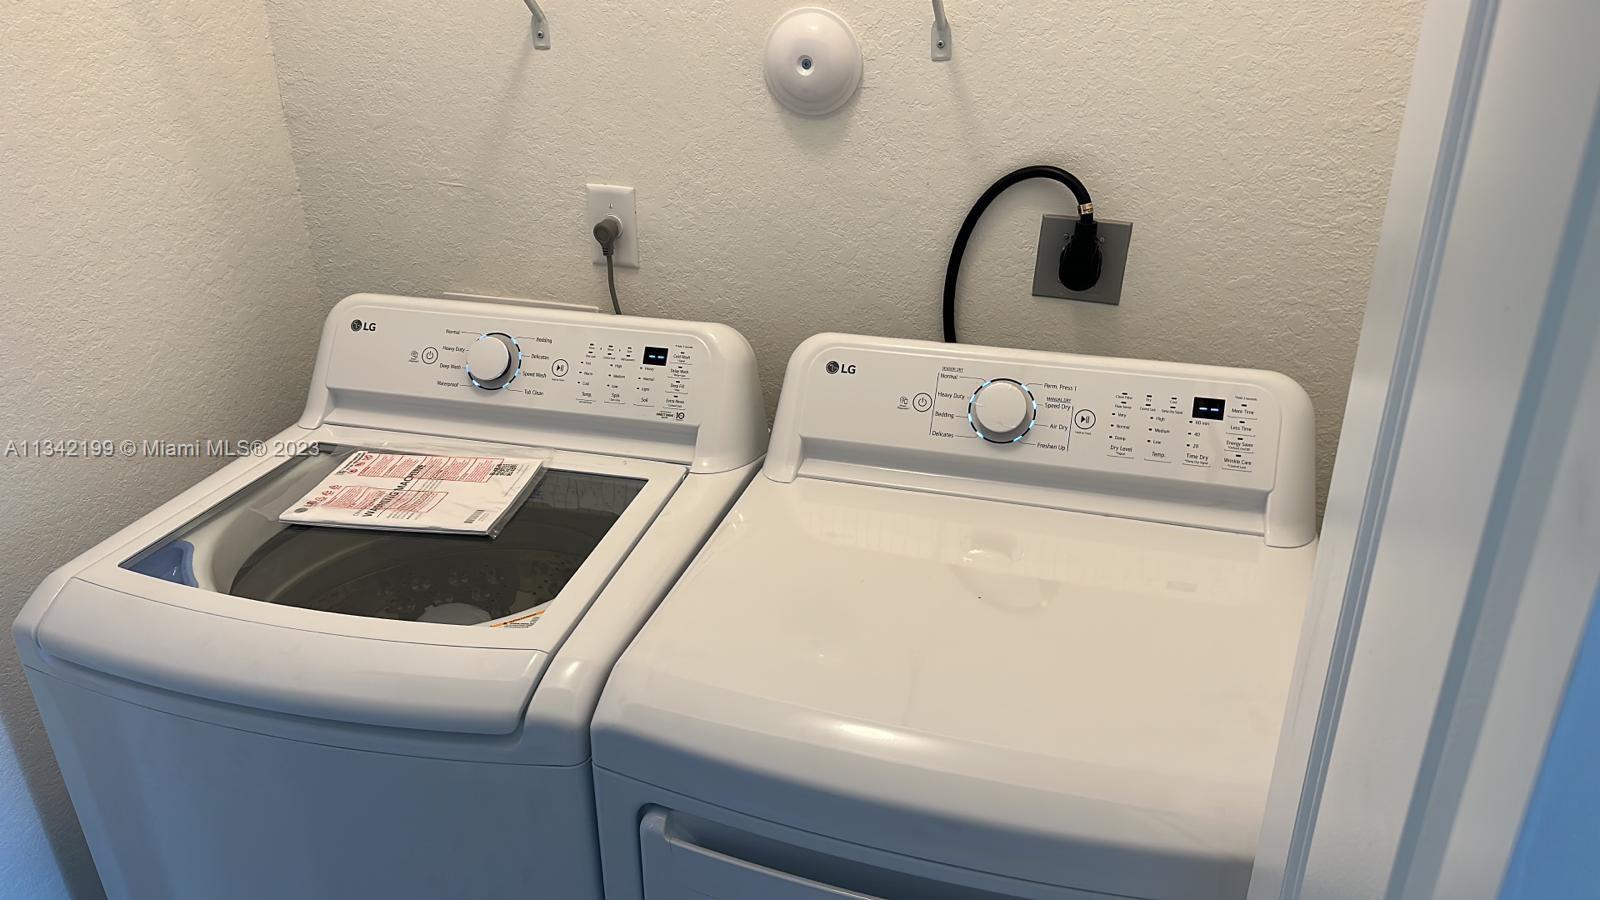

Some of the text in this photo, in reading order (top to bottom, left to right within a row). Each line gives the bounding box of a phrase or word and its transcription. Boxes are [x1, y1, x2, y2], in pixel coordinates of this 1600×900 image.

[363, 322, 376, 331] LG
[841, 364, 856, 374] LG
[935, 411, 954, 419] Bedding
